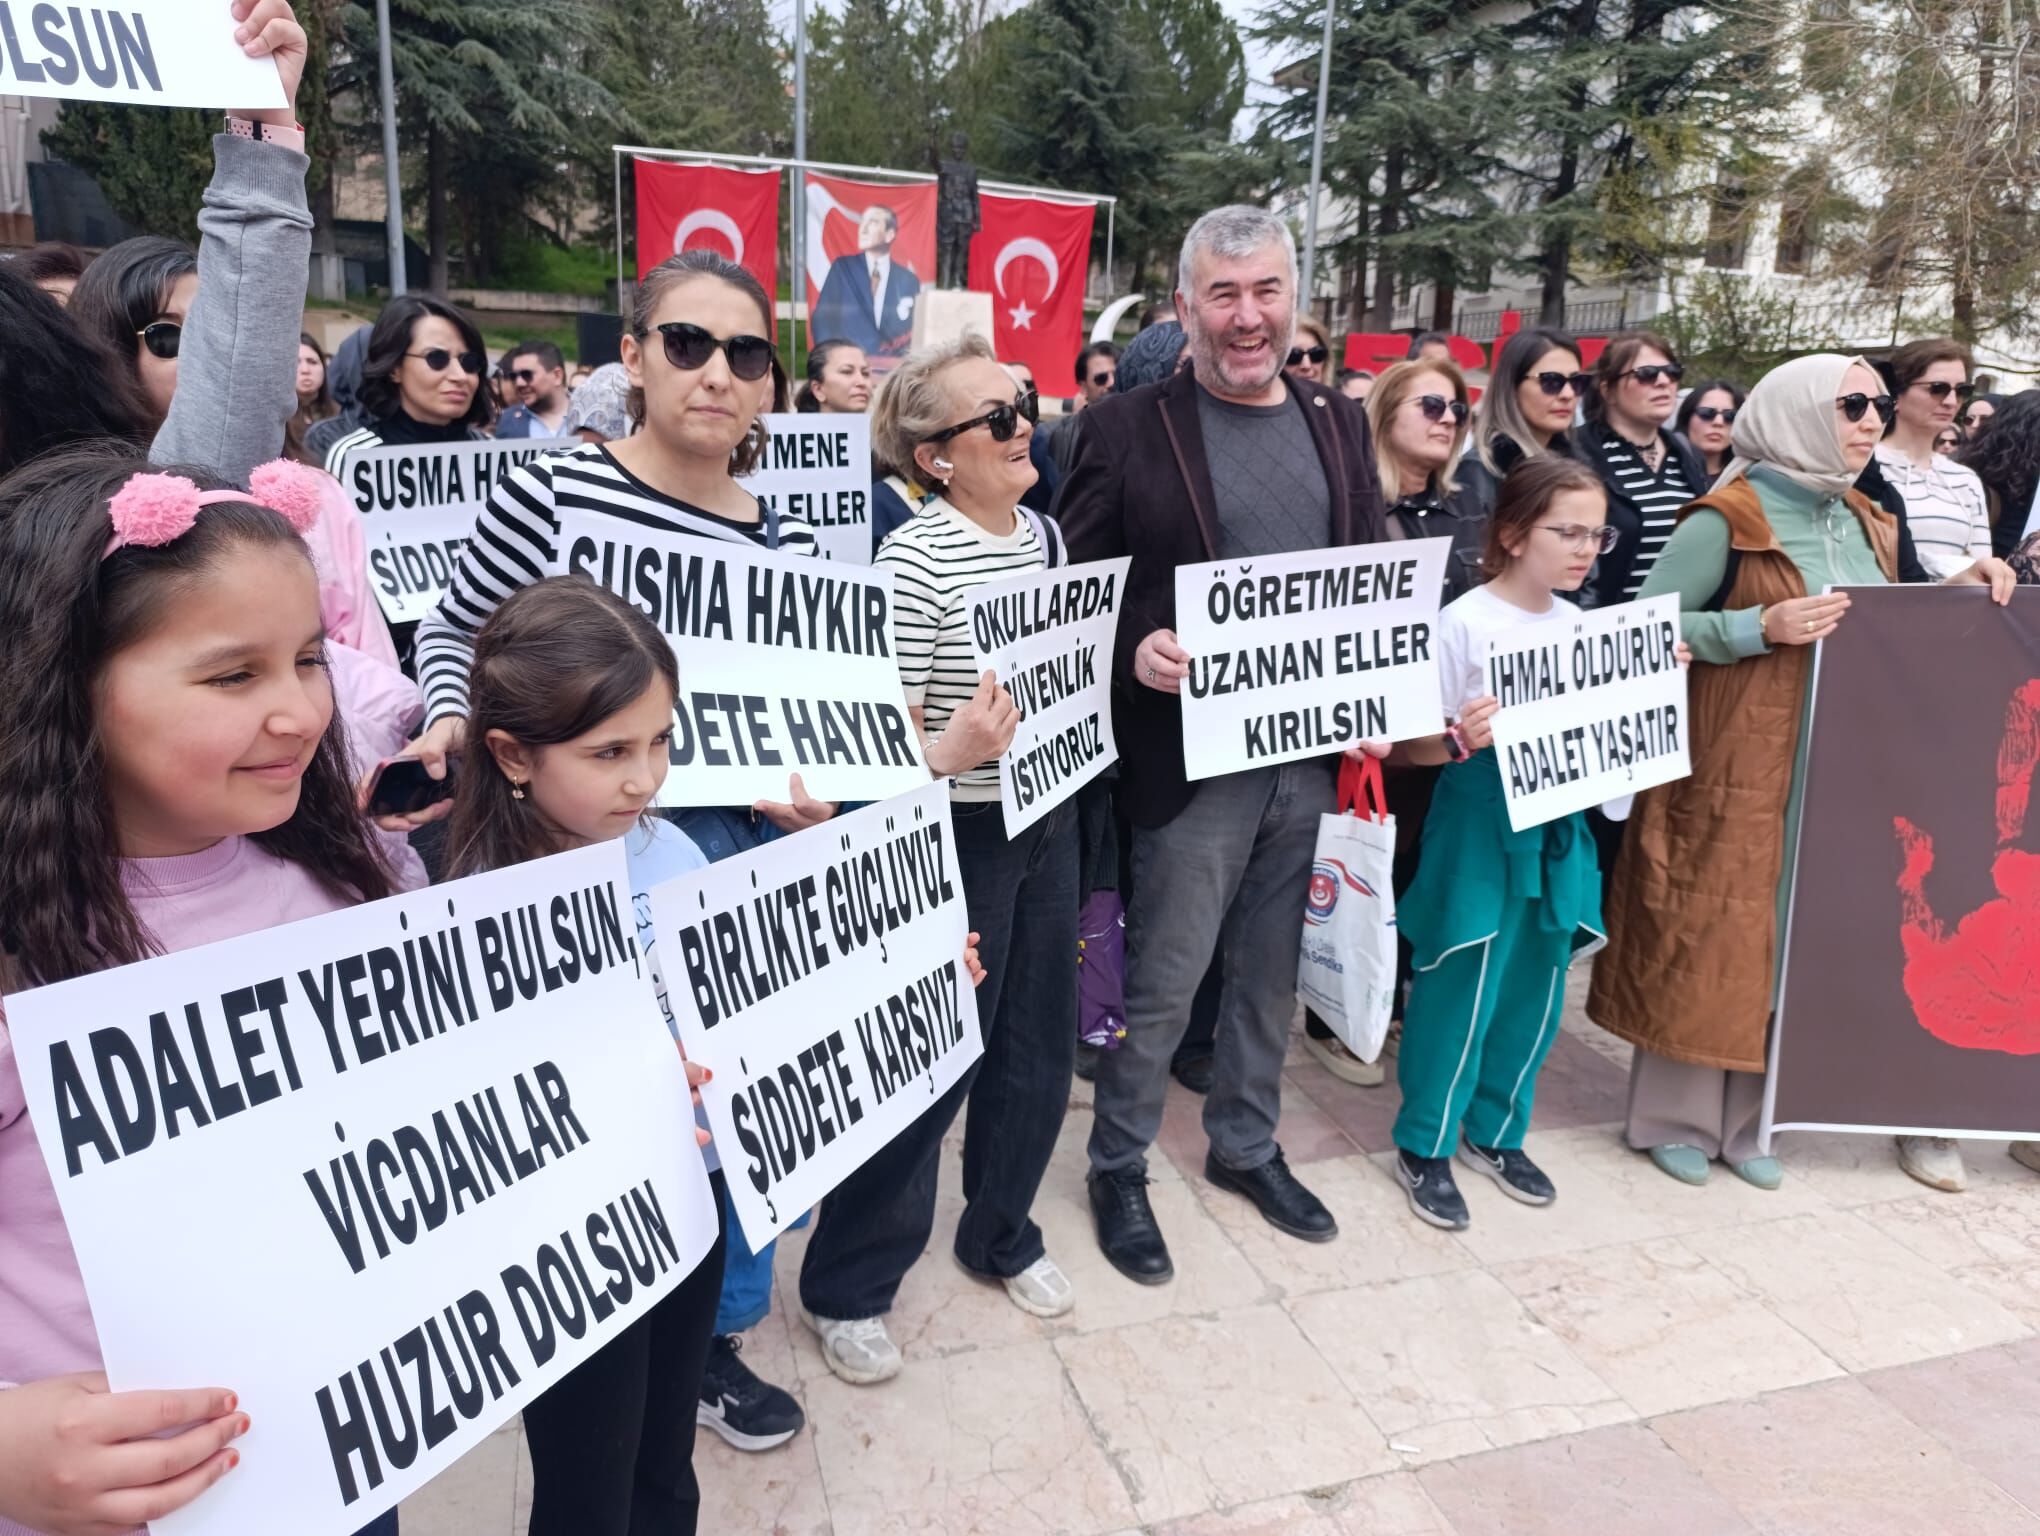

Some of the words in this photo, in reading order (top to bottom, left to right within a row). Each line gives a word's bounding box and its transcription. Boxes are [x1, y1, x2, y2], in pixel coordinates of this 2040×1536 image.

[0, 0, 163, 91] LSUN
[354, 455, 465, 513] SUSMA
[747, 565, 890, 658] HAYKIR
[973, 573, 1116, 654] OKULLARDA
[1207, 559, 1418, 625] ÖĞRETMENE
[1188, 637, 1323, 699] UZANAN
[1335, 622, 1430, 675] ELLER
[1490, 641, 1566, 708] İHMAL
[1572, 609, 1678, 691] ÖLDÜRÜR
[668, 692, 784, 766] DETE
[780, 697, 919, 767] HAYIR
[1009, 712, 1105, 812] İSTİYORUZ
[1244, 695, 1388, 759] KIRILSIN
[1507, 726, 1588, 799] ADALET
[1590, 704, 1679, 781] YAŞATIR
[679, 869, 831, 1030] BİRLİKTE
[825, 806, 955, 963] GÜÇLÜYÜZ
[48, 976, 304, 1178] ADALET
[298, 898, 480, 1074] YERİNİ
[731, 1030, 864, 1224] ŞİDDETE
[855, 959, 964, 1105] KARŞIYIZ
[302, 1060, 591, 1274] VİCDANLAR
[315, 1289, 522, 1507] HUZUR
[500, 1179, 681, 1368] DOLSUN
